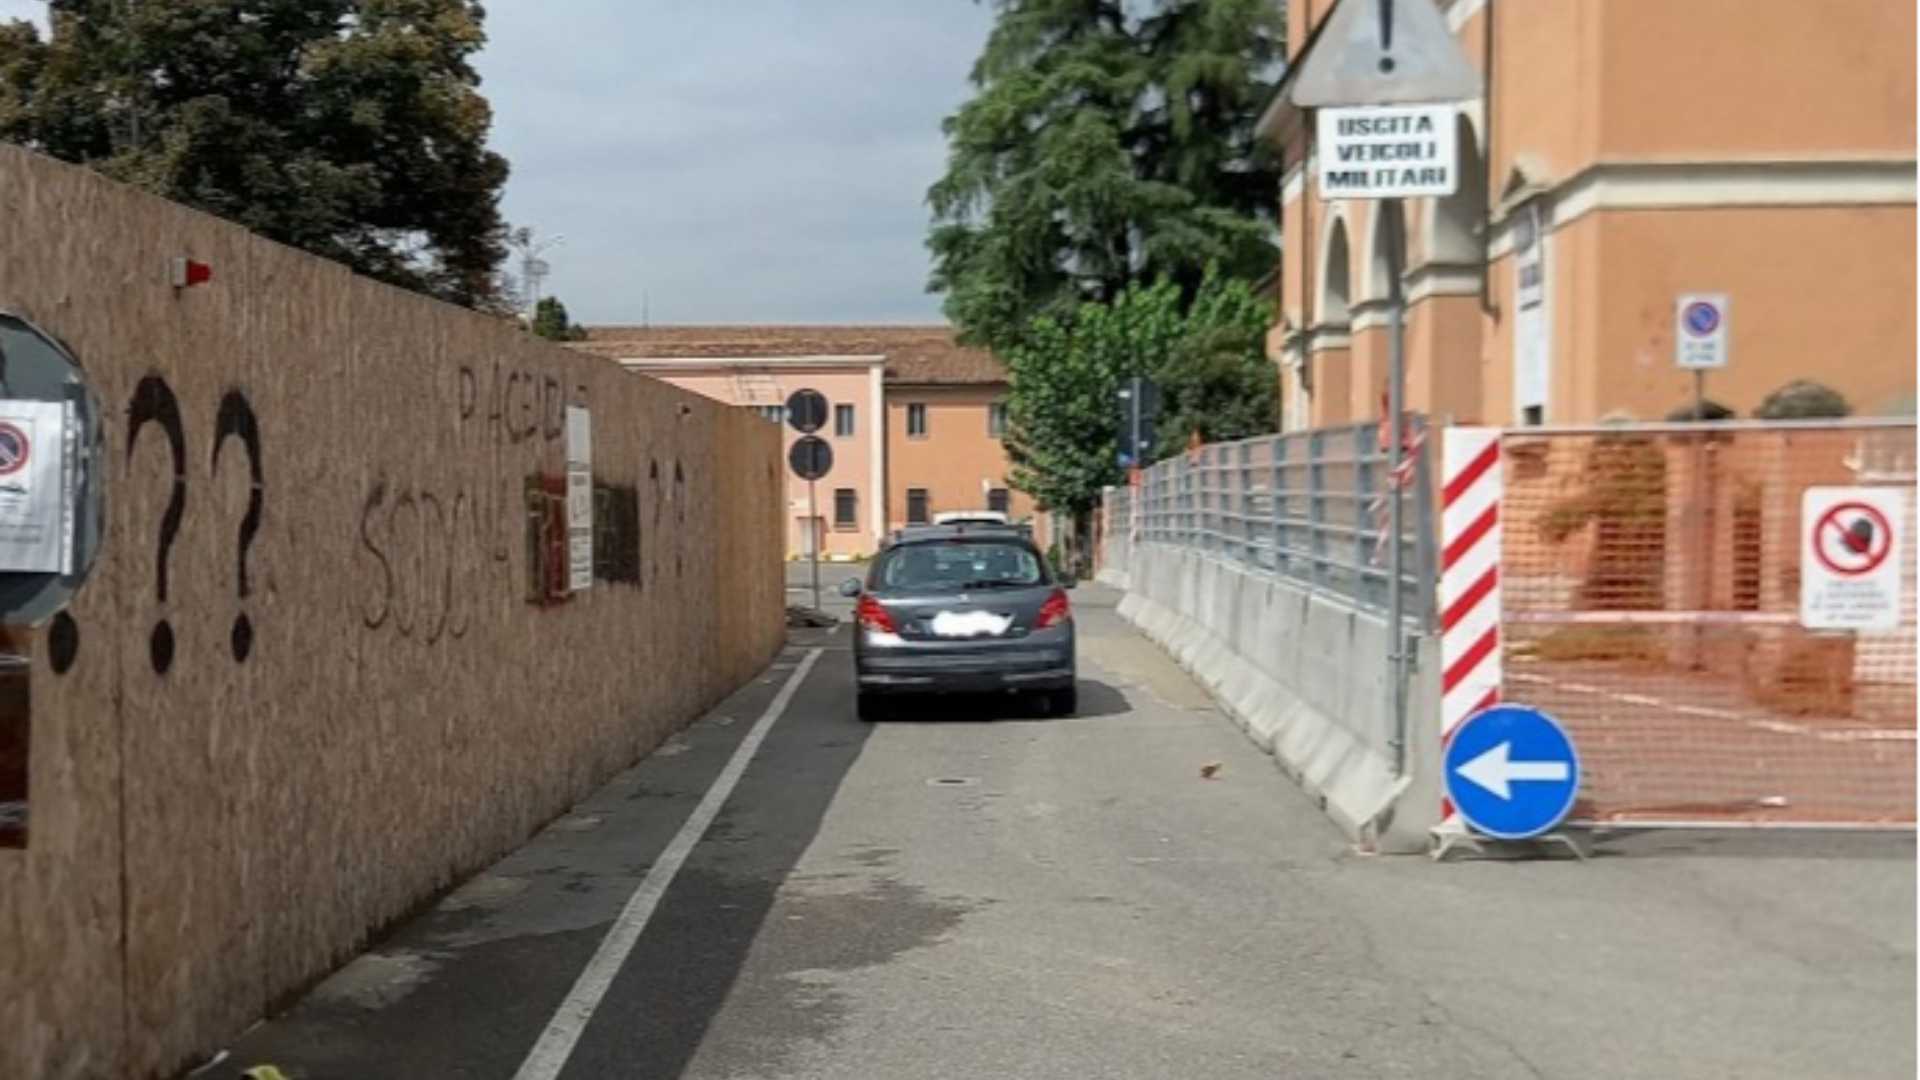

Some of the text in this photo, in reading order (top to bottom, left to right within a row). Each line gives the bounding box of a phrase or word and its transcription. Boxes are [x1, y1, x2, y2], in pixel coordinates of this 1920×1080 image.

[1337, 116, 1433, 136] USCITA
[1337, 142, 1436, 161] VEICOLI
[1327, 167, 1446, 188] MILITARI
